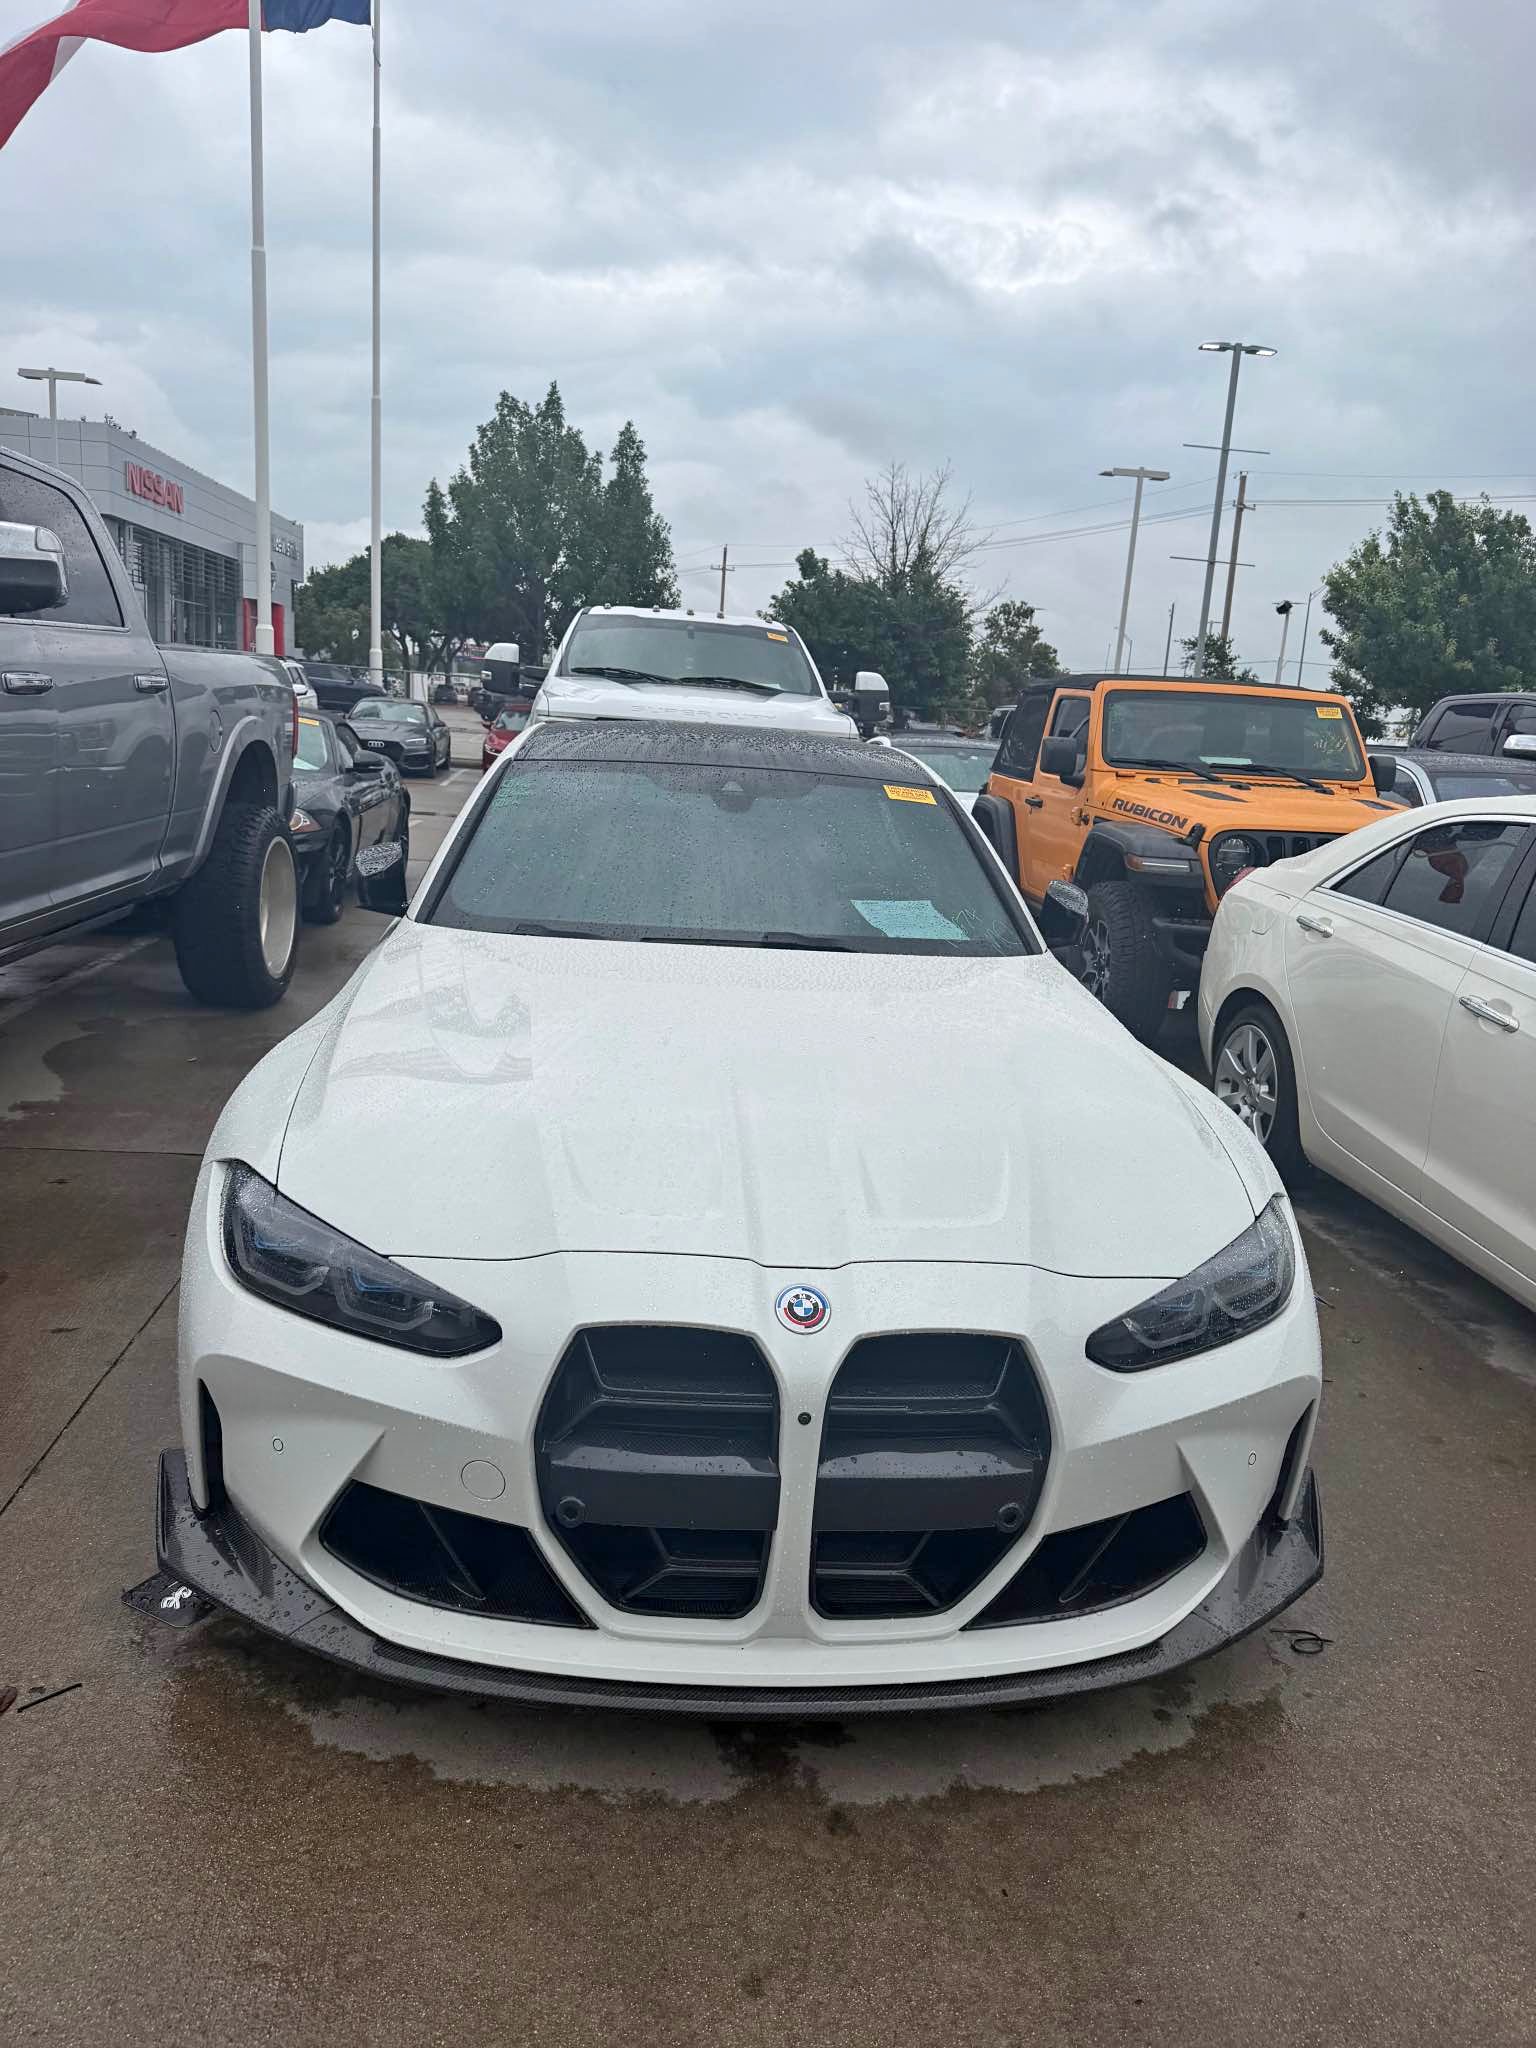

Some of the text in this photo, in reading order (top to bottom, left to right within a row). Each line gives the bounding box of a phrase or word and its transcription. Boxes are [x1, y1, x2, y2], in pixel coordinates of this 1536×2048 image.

[125, 461, 184, 513] NISSAN
[1112, 798, 1188, 829] RUBICON
[790, 1293, 817, 1304] BMW
